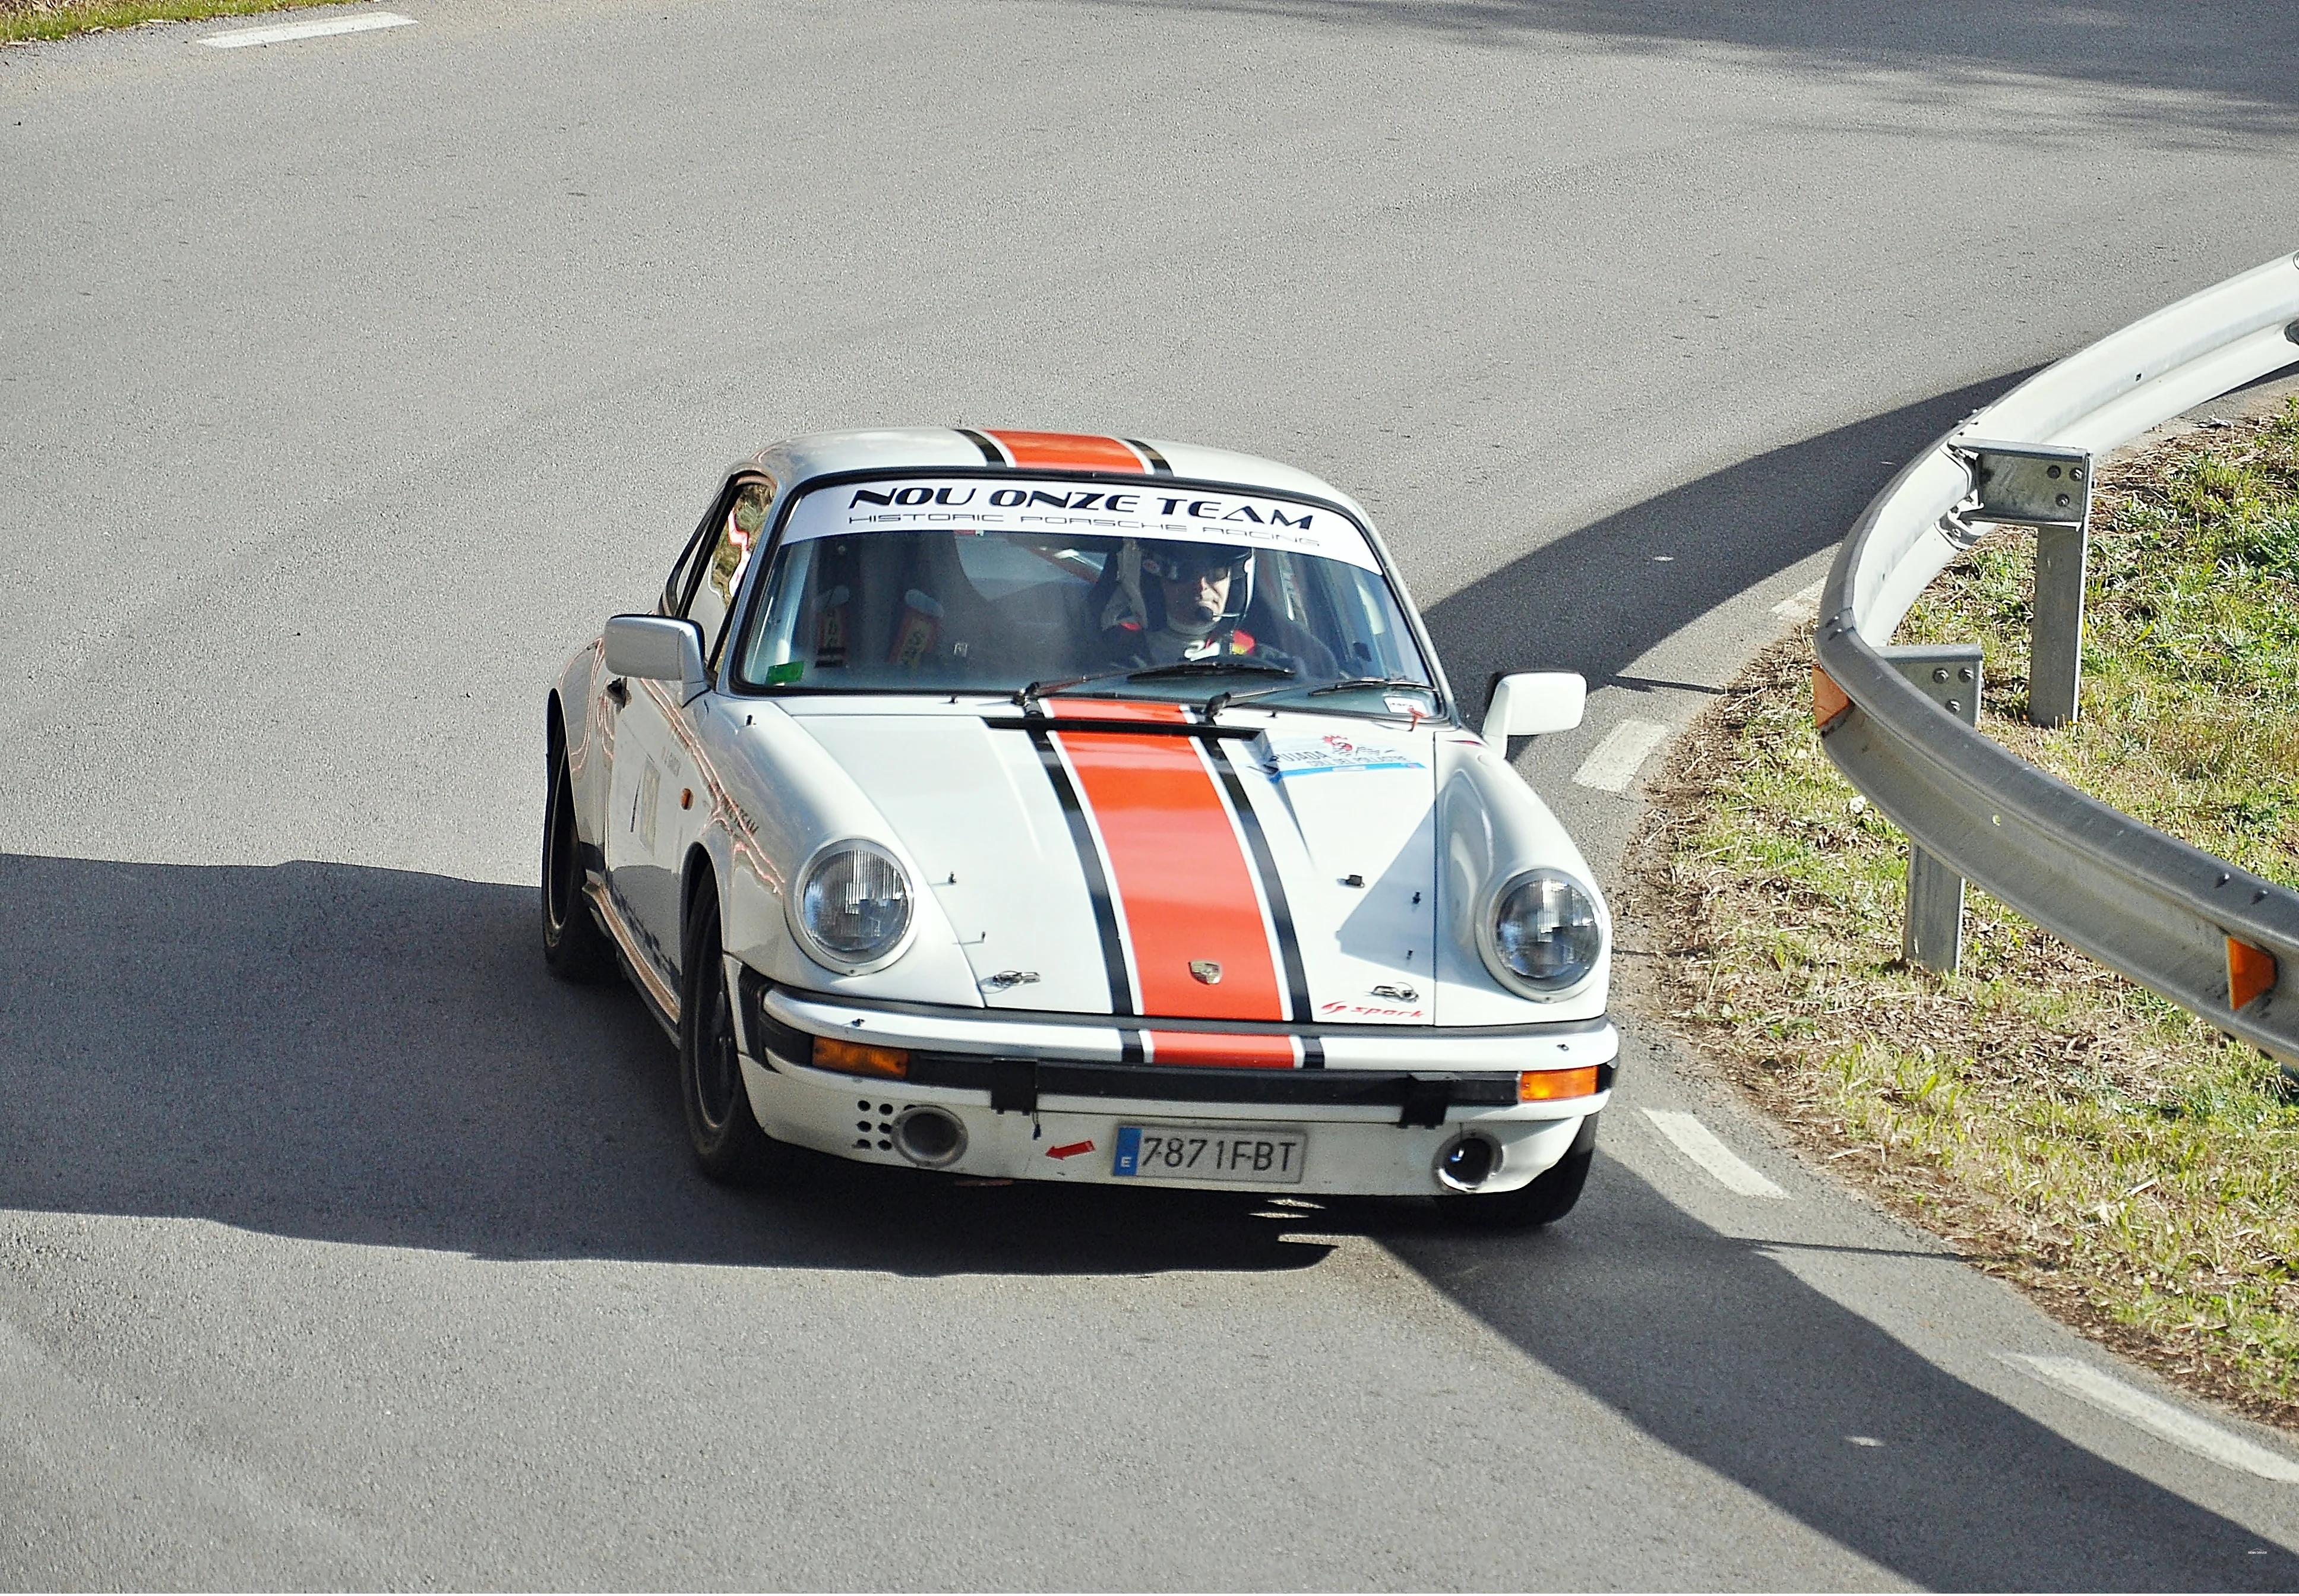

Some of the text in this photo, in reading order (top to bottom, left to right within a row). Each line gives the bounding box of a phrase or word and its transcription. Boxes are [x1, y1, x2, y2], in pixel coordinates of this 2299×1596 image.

[848, 487, 1314, 530] NOU ONZE TEAM
[849, 514, 1320, 547] HISTORIC PORSCHE RACING
[1350, 1006, 1425, 1018] spark
[1120, 1156, 1131, 1168] E
[1142, 1137, 1297, 1172] 7871FBT
